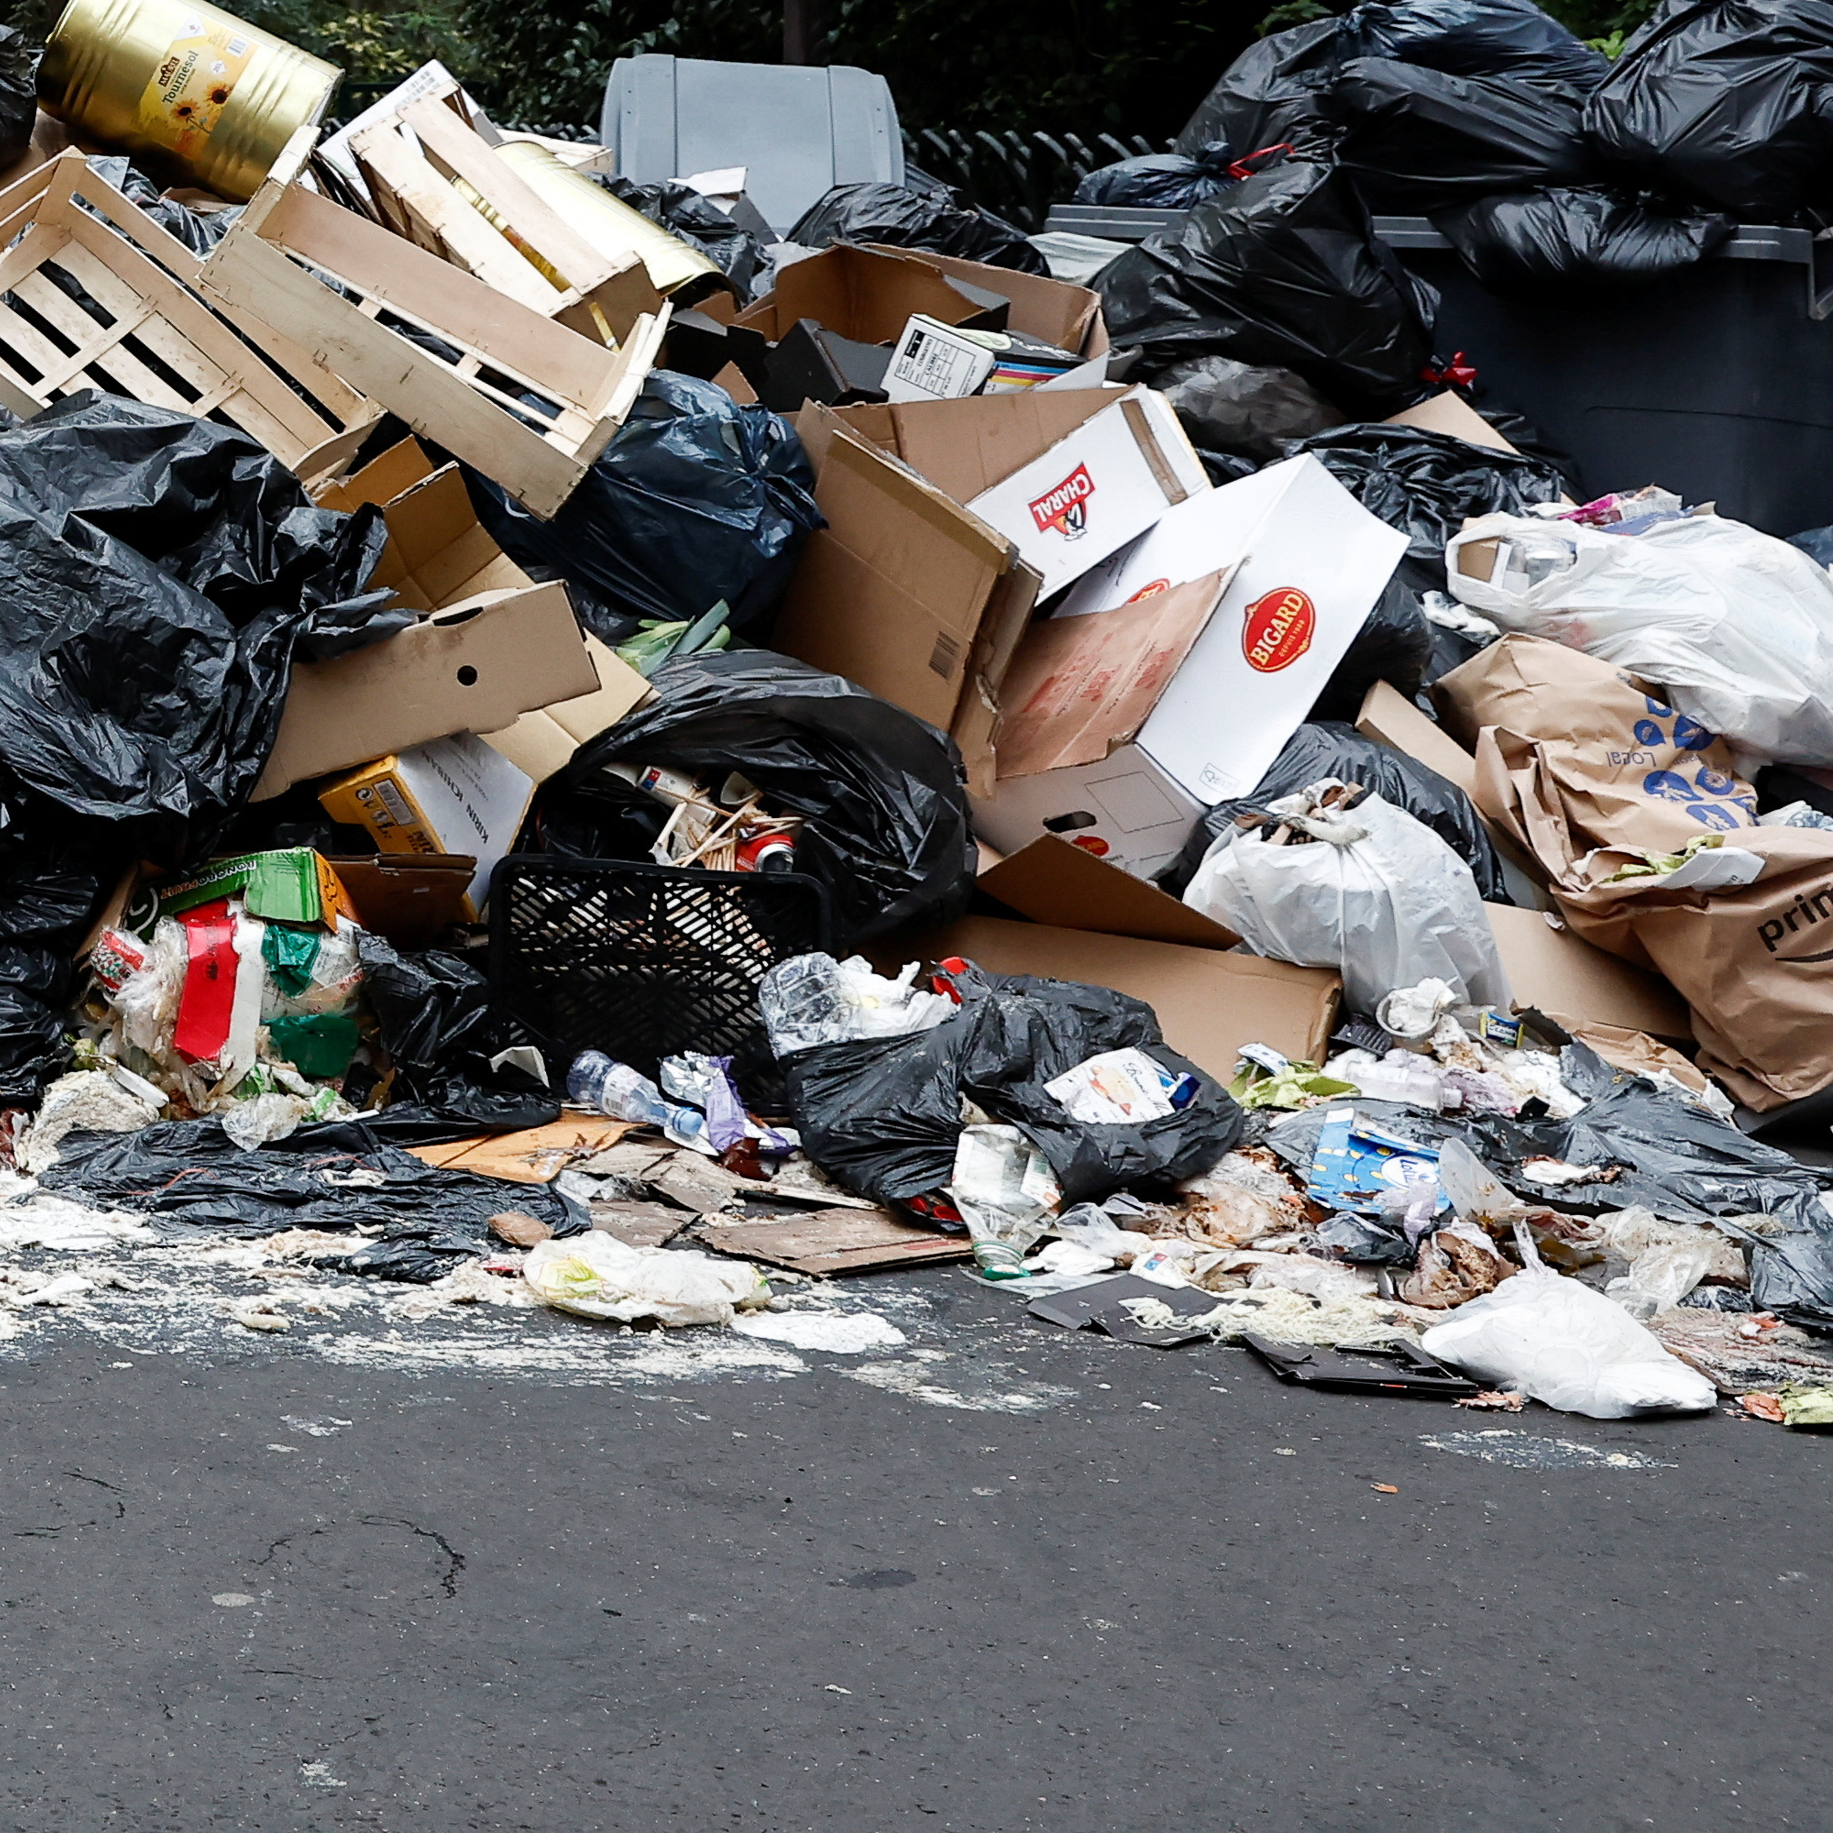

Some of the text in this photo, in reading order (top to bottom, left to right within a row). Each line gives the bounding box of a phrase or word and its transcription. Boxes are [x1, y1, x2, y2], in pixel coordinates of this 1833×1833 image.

[162, 50, 199, 104] Tournesol
[1033, 473, 1091, 522] CHARAL
[1250, 592, 1304, 666] BIGARD
[1606, 748, 1656, 767] Local
[465, 803, 489, 845] KIRIN
